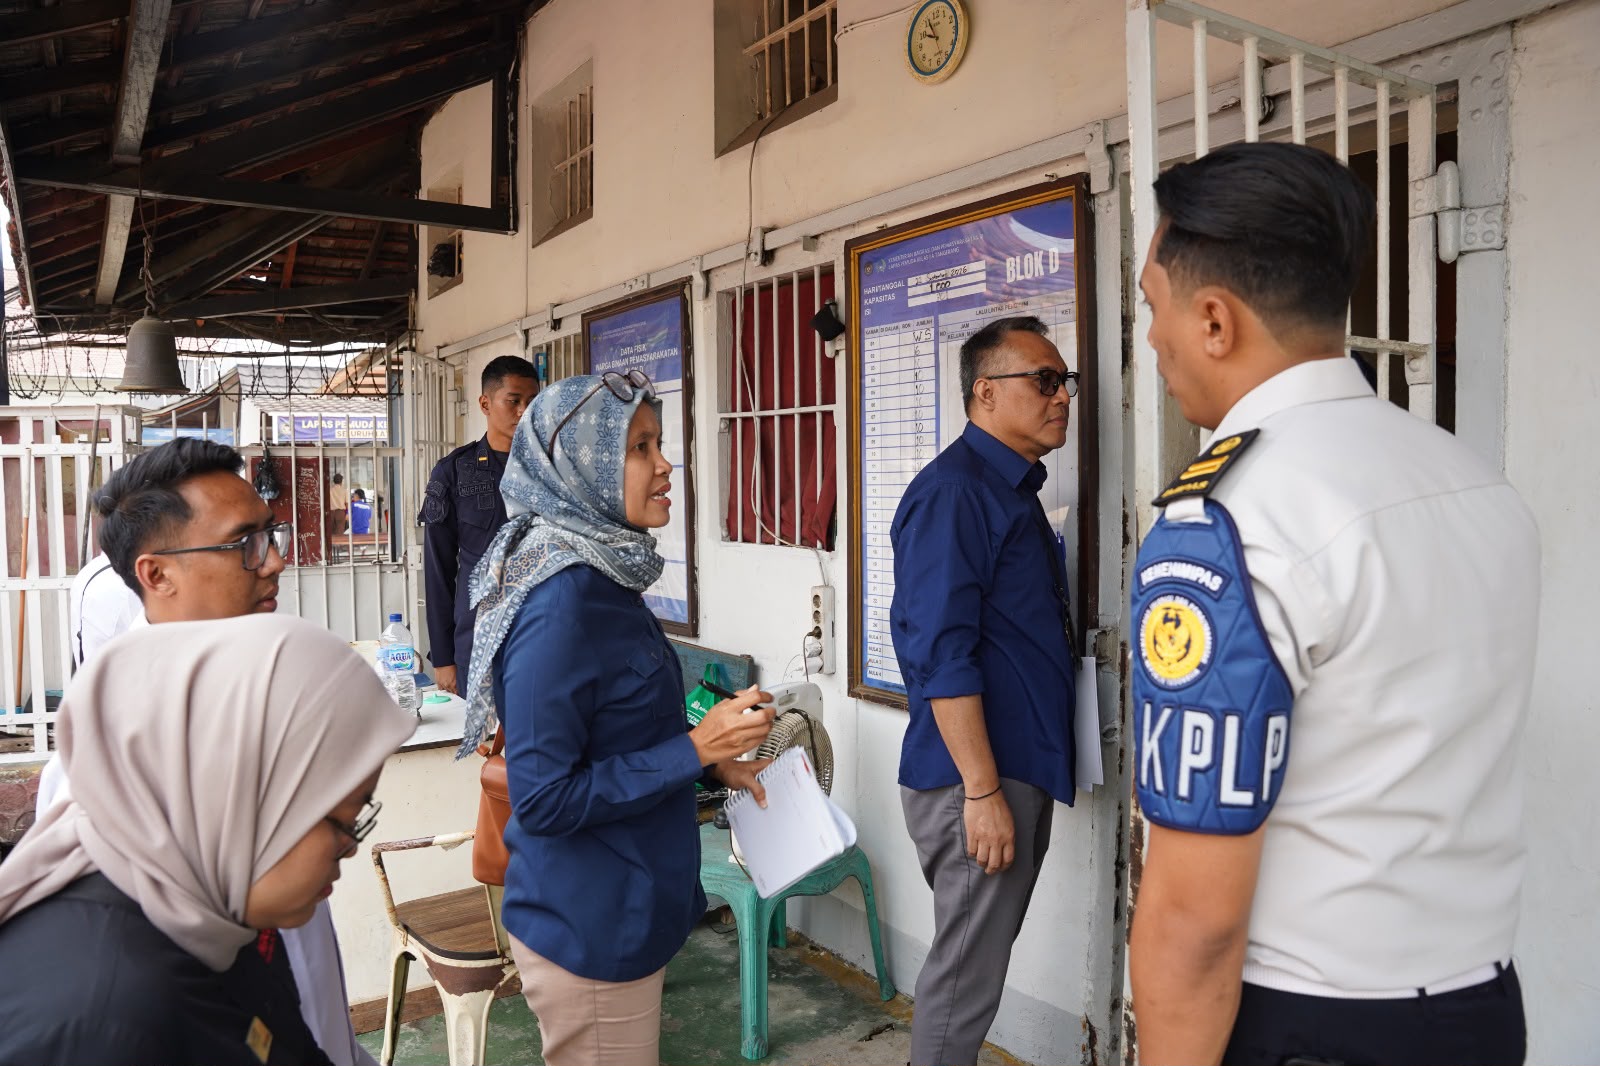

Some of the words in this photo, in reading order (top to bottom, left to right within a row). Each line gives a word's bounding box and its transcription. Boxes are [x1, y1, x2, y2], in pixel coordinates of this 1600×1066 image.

[932, 10, 940, 20] 12
[948, 16, 953, 24] 2
[920, 31, 926, 40] 10
[919, 43, 922, 51] 9
[922, 53, 926, 61] 8
[928, 58, 932, 67] 7
[936, 58, 940, 66] 6
[1006, 250, 1044, 284] BLOK
[1048, 247, 1060, 274] D
[864, 293, 896, 305] KAPASITAS
[620, 346, 634, 356] DATA
[634, 344, 647, 353] FISIK
[595, 362, 611, 372] WARGA
[612, 358, 629, 368] BINAAN
[630, 347, 678, 364] PEMASYARAKATAN
[302, 420, 334, 429] LAPAS
[335, 420, 373, 429] PEMUDA
[390, 652, 412, 662] AQUA
[1140, 702, 1288, 806] KPLP
